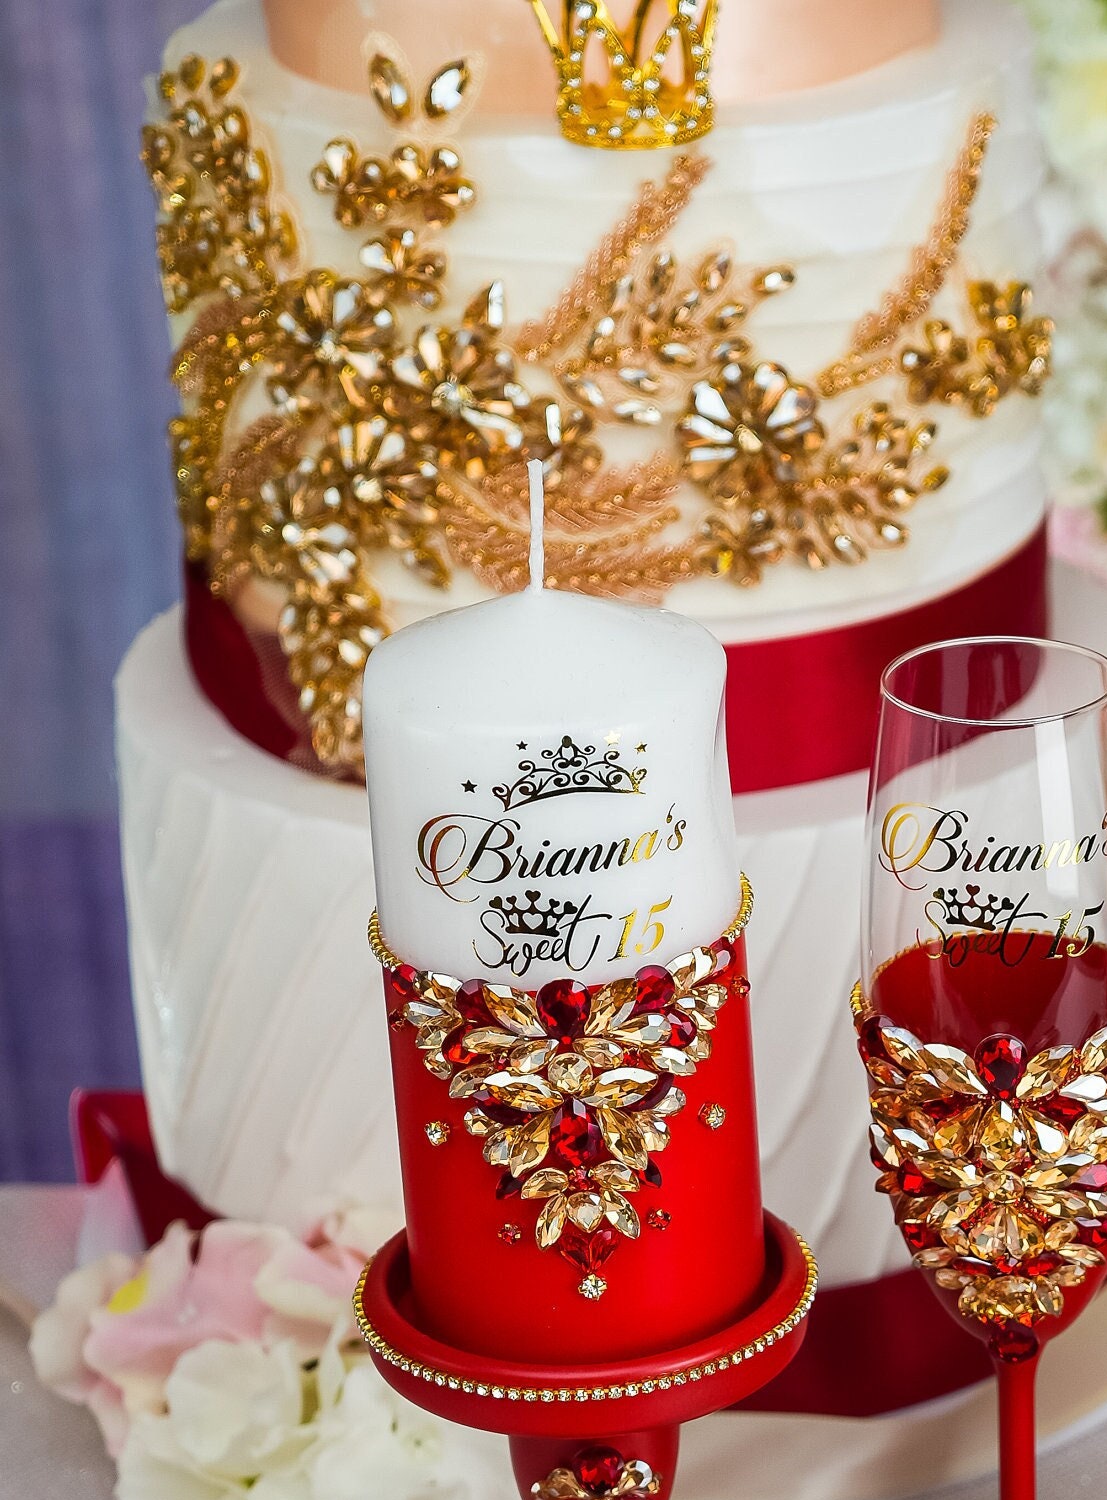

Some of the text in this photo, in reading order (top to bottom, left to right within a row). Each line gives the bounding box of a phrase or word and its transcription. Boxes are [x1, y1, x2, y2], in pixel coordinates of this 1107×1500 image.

[415, 803, 687, 904] Brianna's
[472, 894, 673, 977] Sweet 15
[916, 892, 1105, 967] Sweet 15
